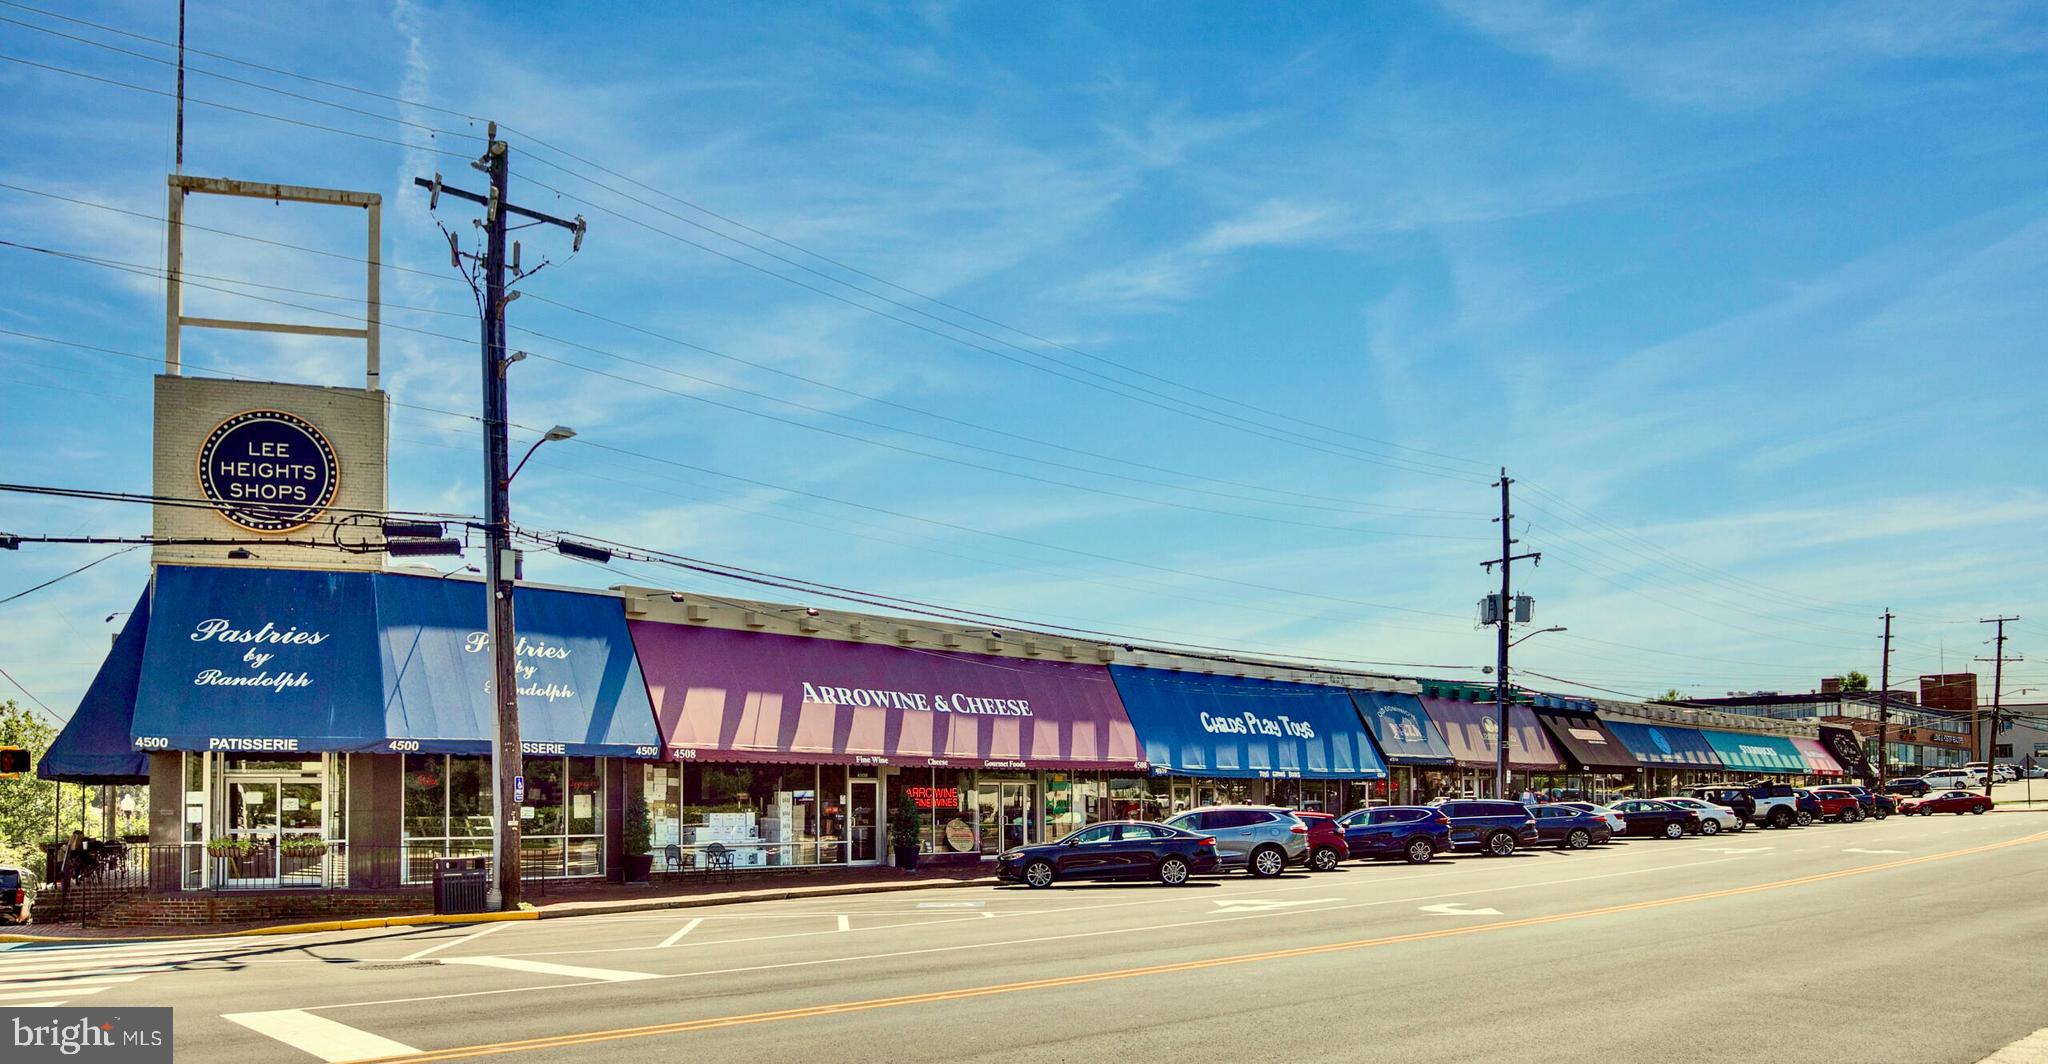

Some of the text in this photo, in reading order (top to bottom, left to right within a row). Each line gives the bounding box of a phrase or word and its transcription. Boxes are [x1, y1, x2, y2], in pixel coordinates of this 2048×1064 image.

[249, 442, 289, 458] LEE
[221, 462, 316, 481] HEIGHTS
[230, 483, 307, 500] SHOPS
[190, 618, 330, 645] Pastries
[464, 631, 571, 660] Ptries
[243, 647, 274, 669] by
[194, 669, 313, 693] Randolph
[802, 681, 1034, 717] ARROWINE & CHEESE
[135, 737, 298, 750] 4500 PATISSERIE
[389, 740, 419, 752] 4500
[635, 746, 659, 756] 4500
[673, 749, 697, 759] 4508
[856, 756, 871, 764] Fine
[871, 756, 889, 764] Wine
[927, 758, 949, 766] Cheese
[984, 760, 1009, 768] Gourmet
[1009, 761, 1027, 769] Foods
